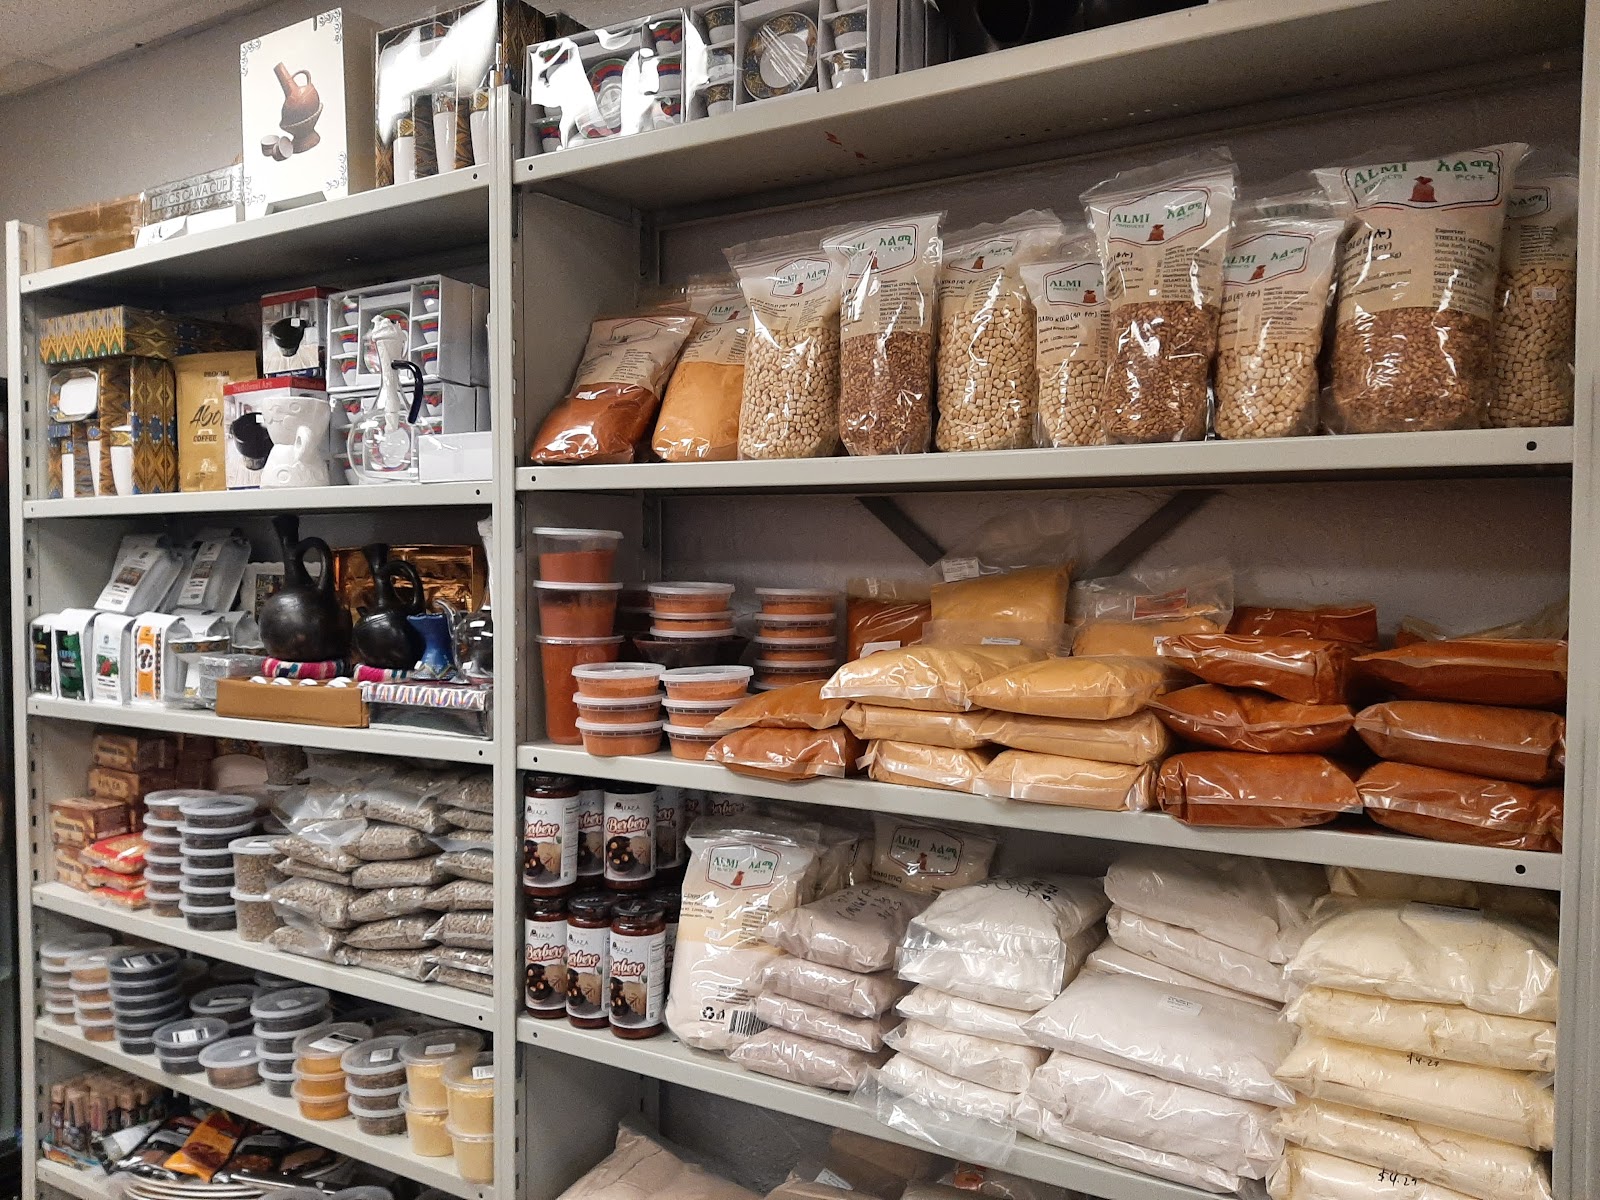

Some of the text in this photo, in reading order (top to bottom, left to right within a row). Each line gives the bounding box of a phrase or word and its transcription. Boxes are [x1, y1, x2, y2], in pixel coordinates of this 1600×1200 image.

[1354, 163, 1408, 188] ALMI
[153, 179, 228, 208] 12PCS CAWA CUP
[1112, 212, 1150, 225] ALMI
[879, 235, 913, 247] አልሚ
[1224, 254, 1257, 264] ALMI
[1049, 280, 1082, 288] ALMI
[262, 380, 273, 389] Art
[193, 434, 218, 443] COFFEE
[894, 834, 921, 849] ALMI
[711, 856, 739, 870] ALMI
